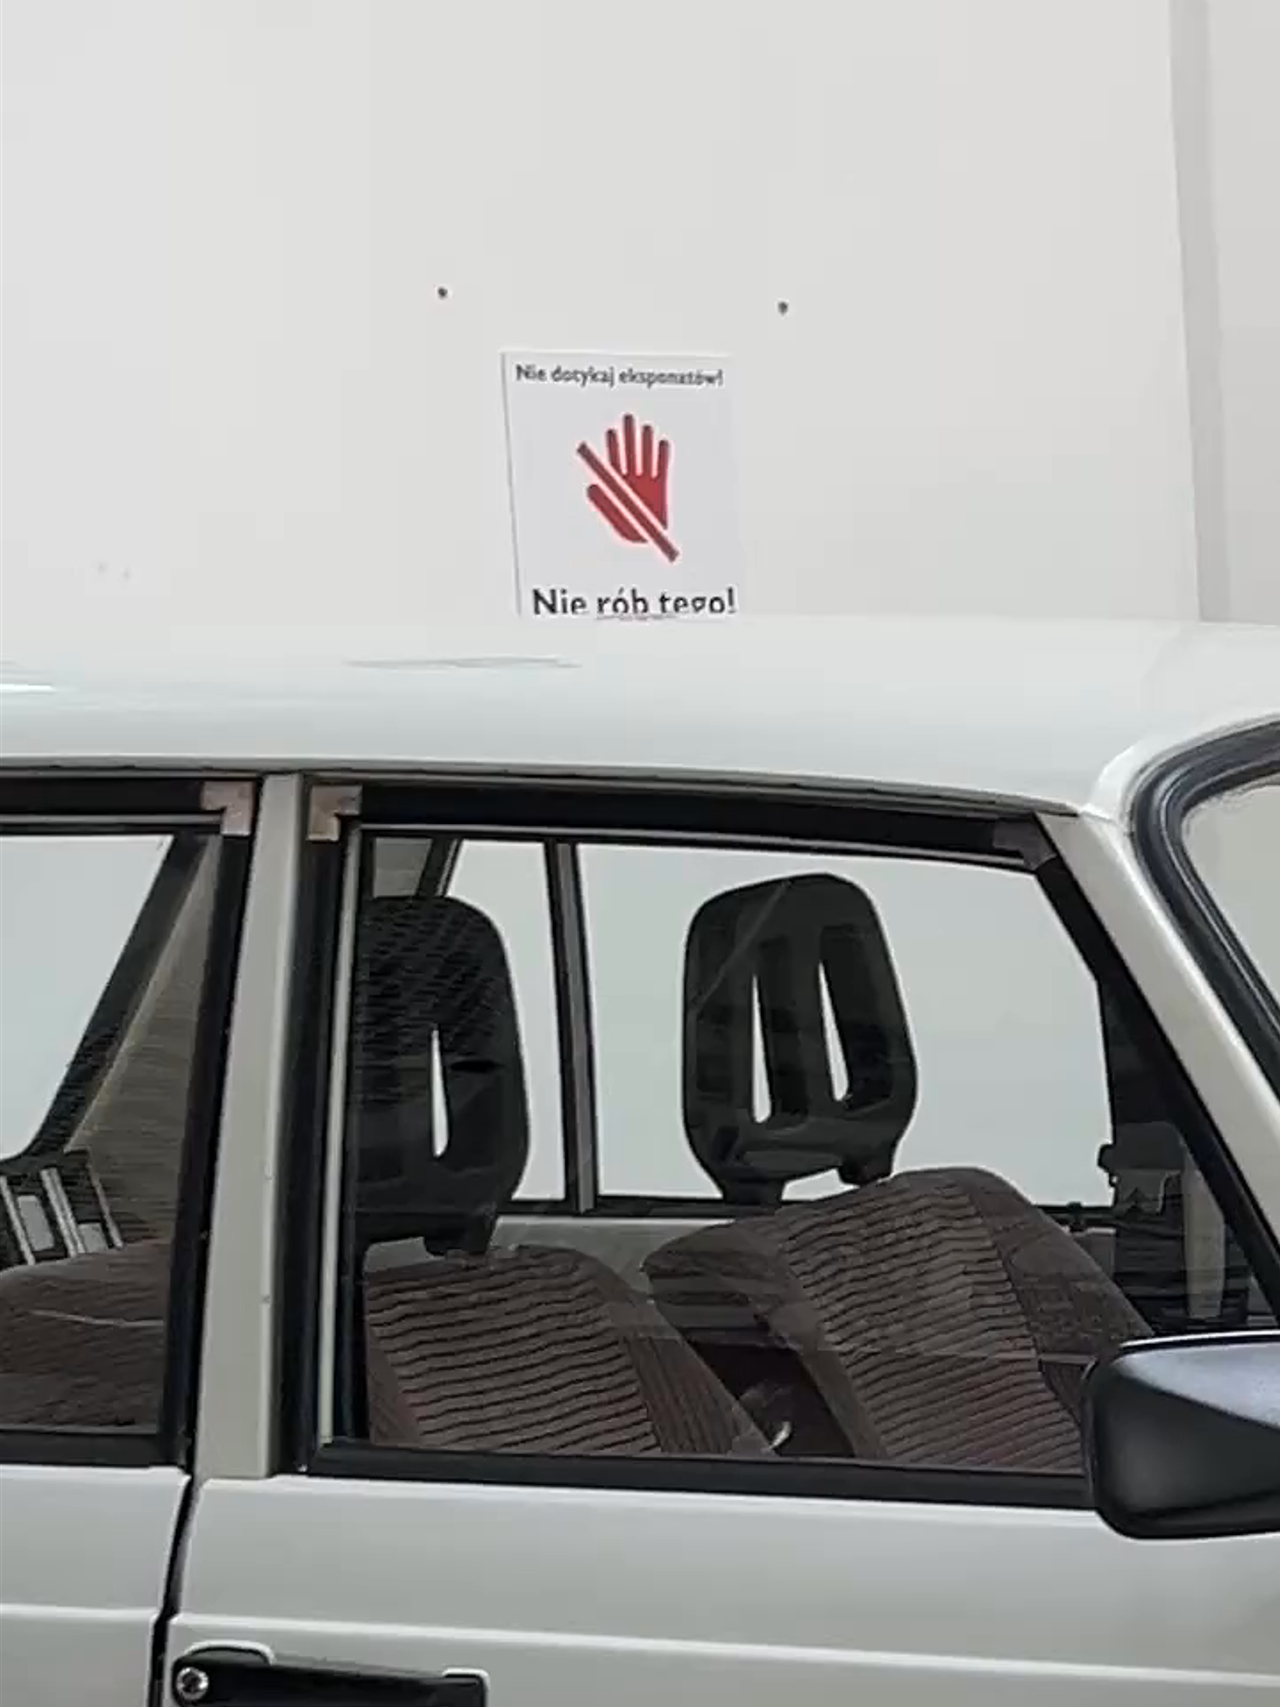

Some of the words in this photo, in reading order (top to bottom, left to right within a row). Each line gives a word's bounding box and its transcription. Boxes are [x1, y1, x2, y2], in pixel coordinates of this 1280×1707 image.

[516, 364, 547, 382] Nie
[551, 364, 615, 388] dotykaj
[619, 367, 723, 389] eksponatów!
[532, 588, 587, 615] Nie
